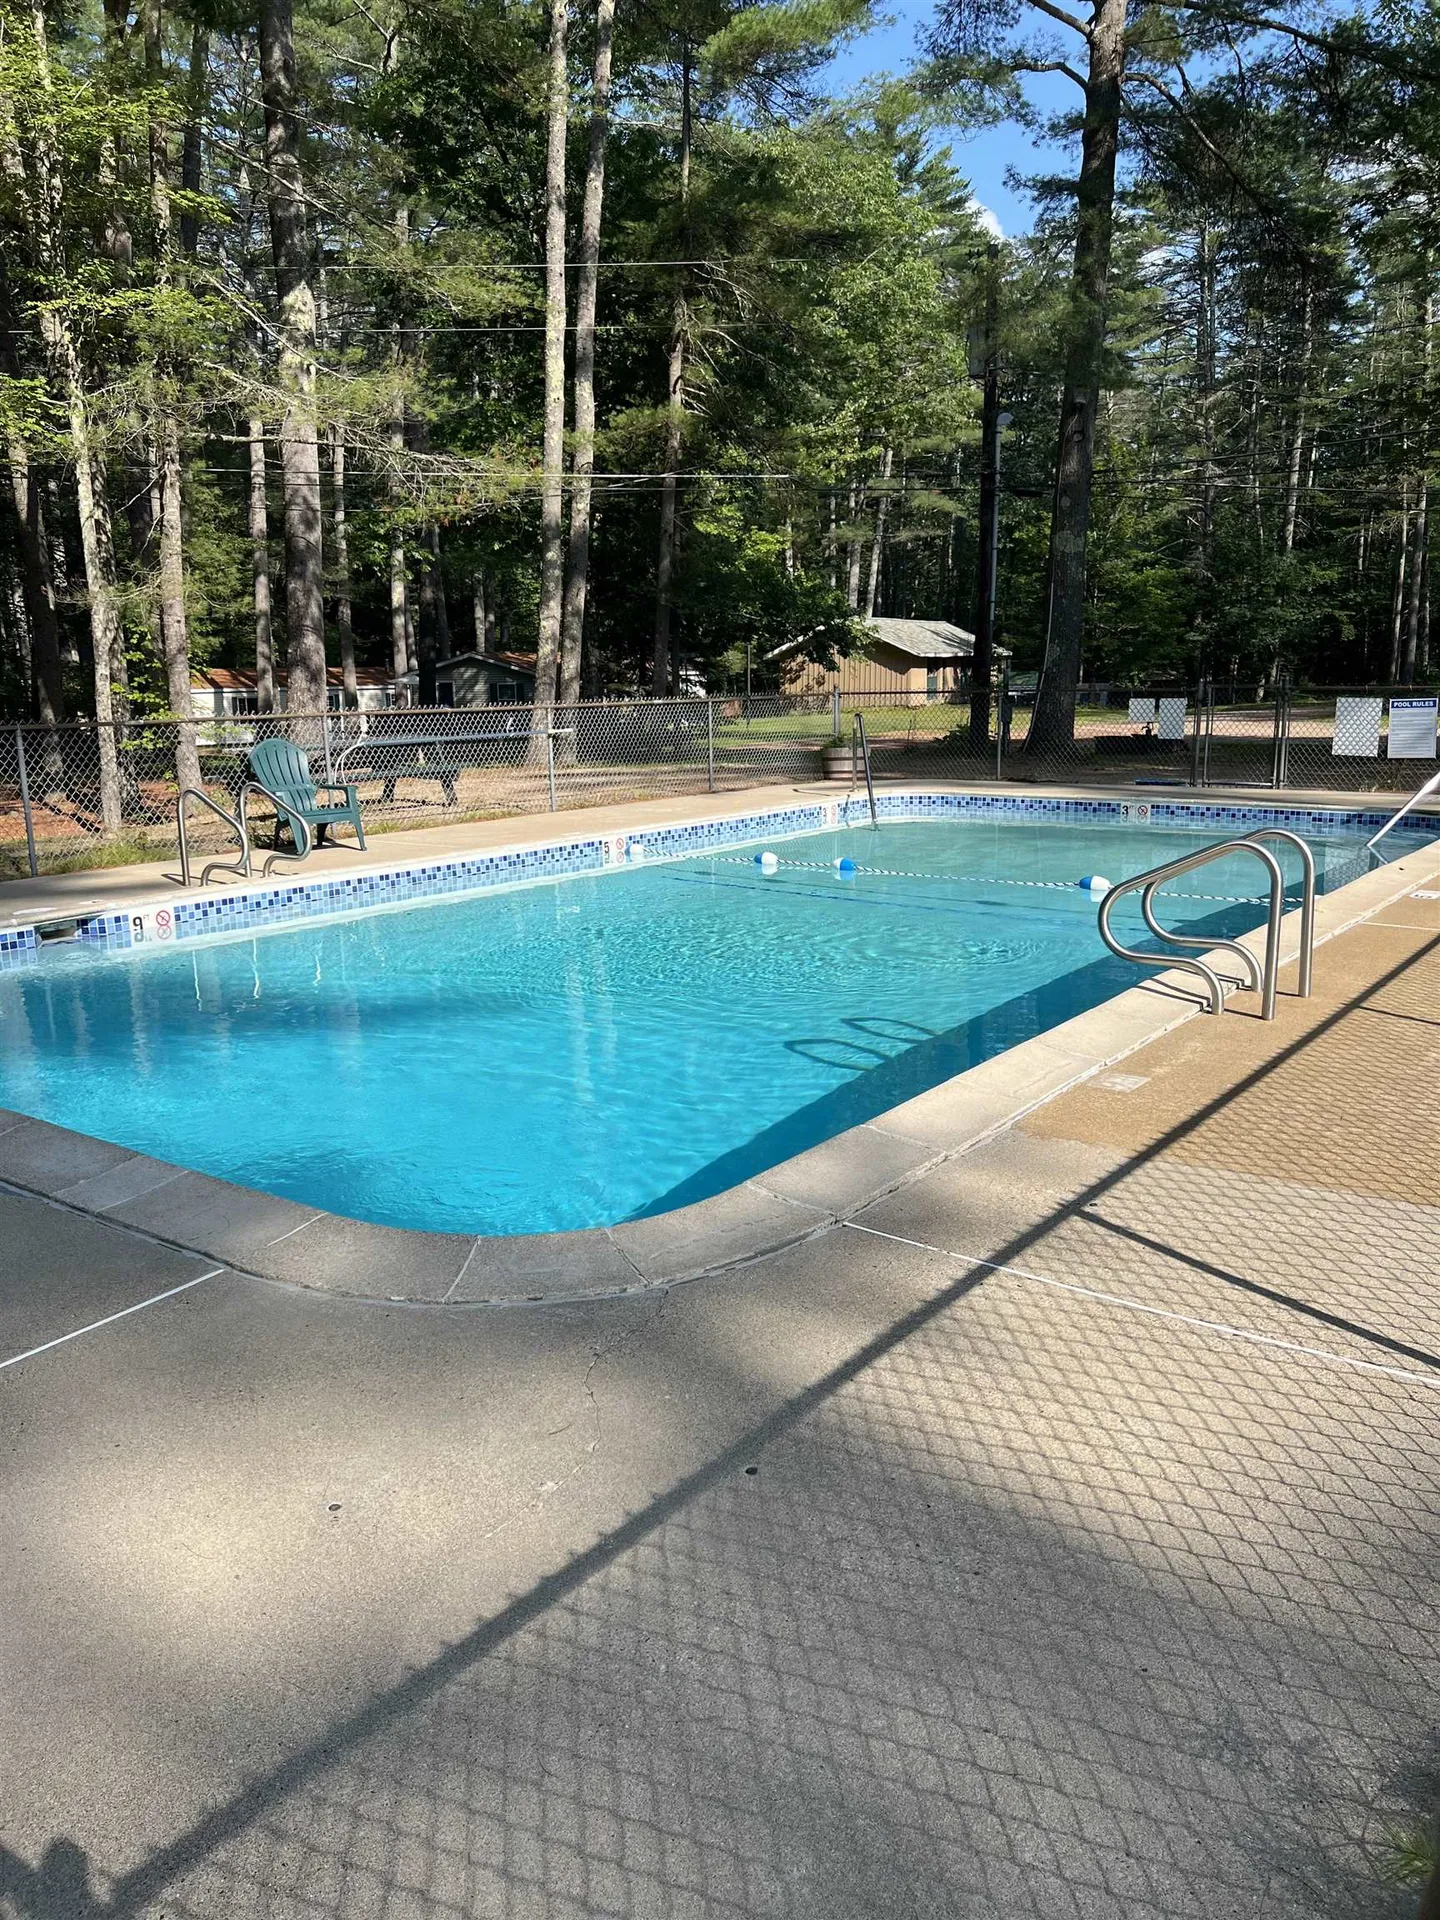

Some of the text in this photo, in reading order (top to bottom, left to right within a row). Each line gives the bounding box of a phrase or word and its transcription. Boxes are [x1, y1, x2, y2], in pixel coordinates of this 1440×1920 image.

[1122, 805, 1129, 815] 3
[604, 841, 610, 854] 5
[132, 916, 143, 931] 9
